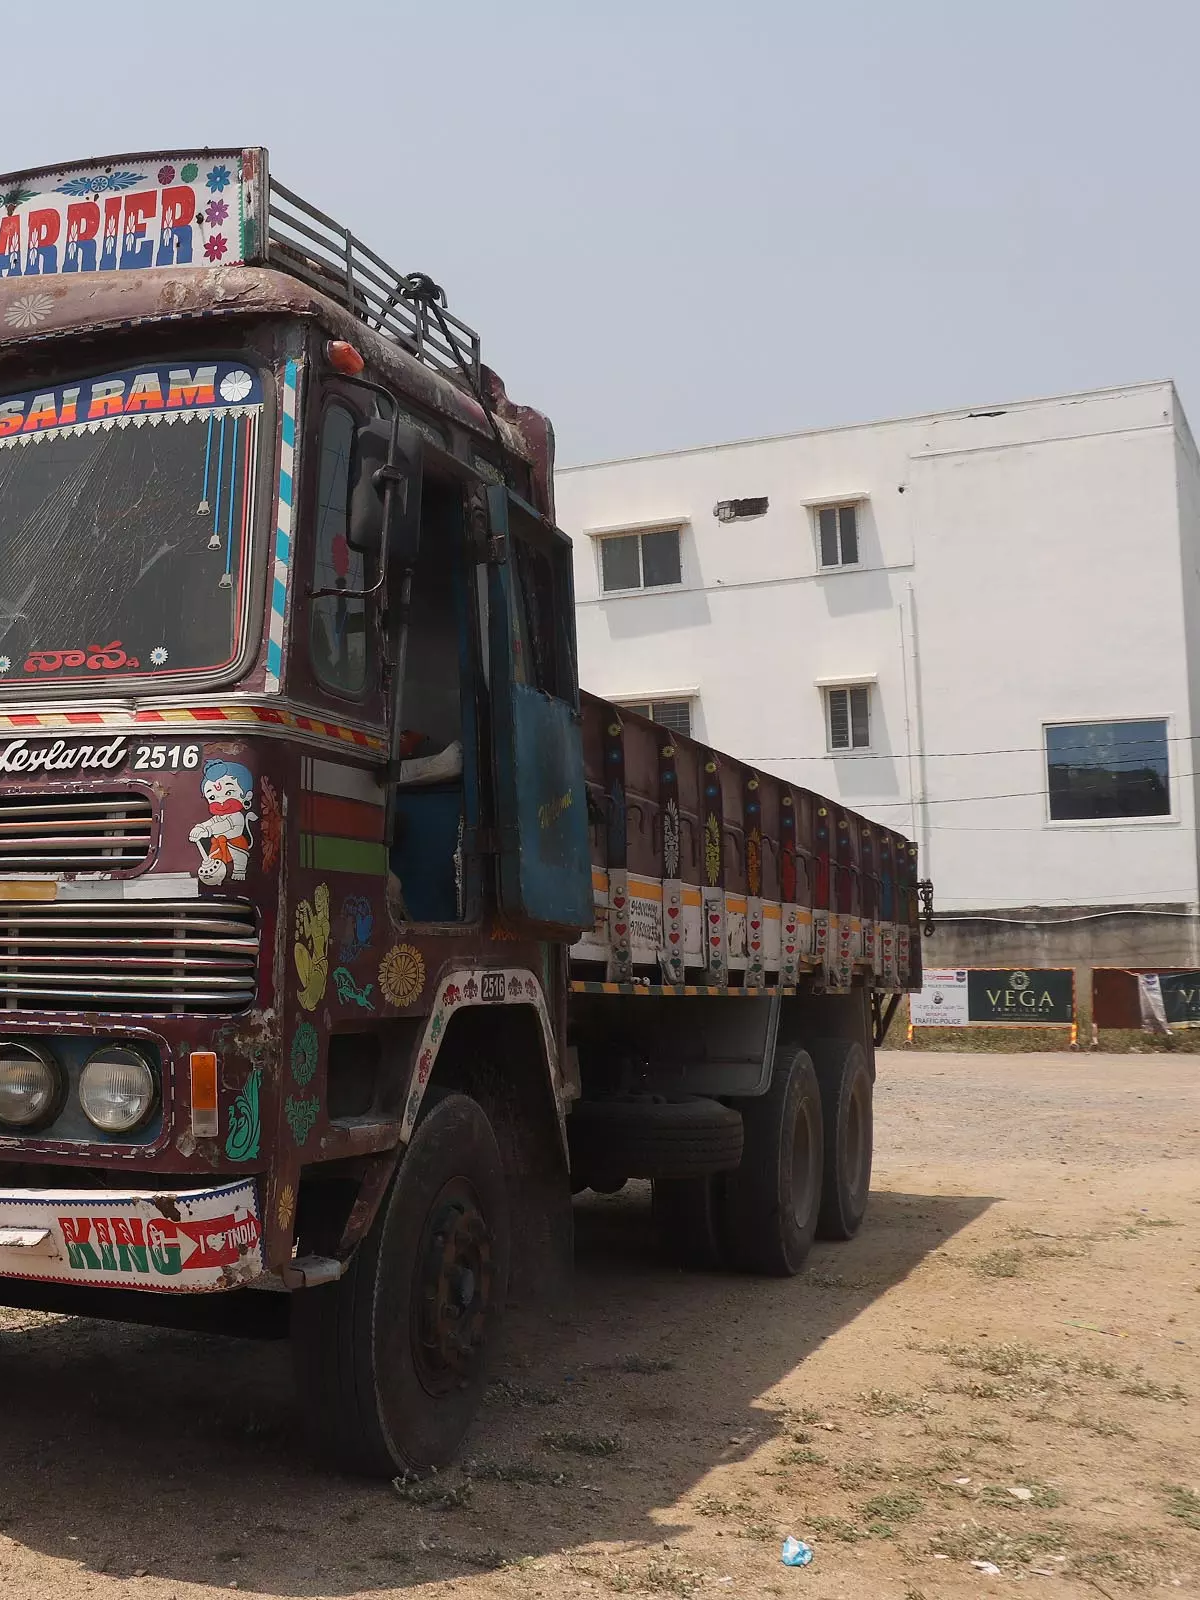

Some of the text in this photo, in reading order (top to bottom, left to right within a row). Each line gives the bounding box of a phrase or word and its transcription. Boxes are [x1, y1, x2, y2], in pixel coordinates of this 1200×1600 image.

[87, 366, 219, 420] RAM
[134, 744, 199, 770] 2516
[482, 975, 505, 998] 2516
[985, 989, 1055, 1007] VEGA
[57, 1216, 186, 1276] KING
[225, 1220, 259, 1249] INDIA
